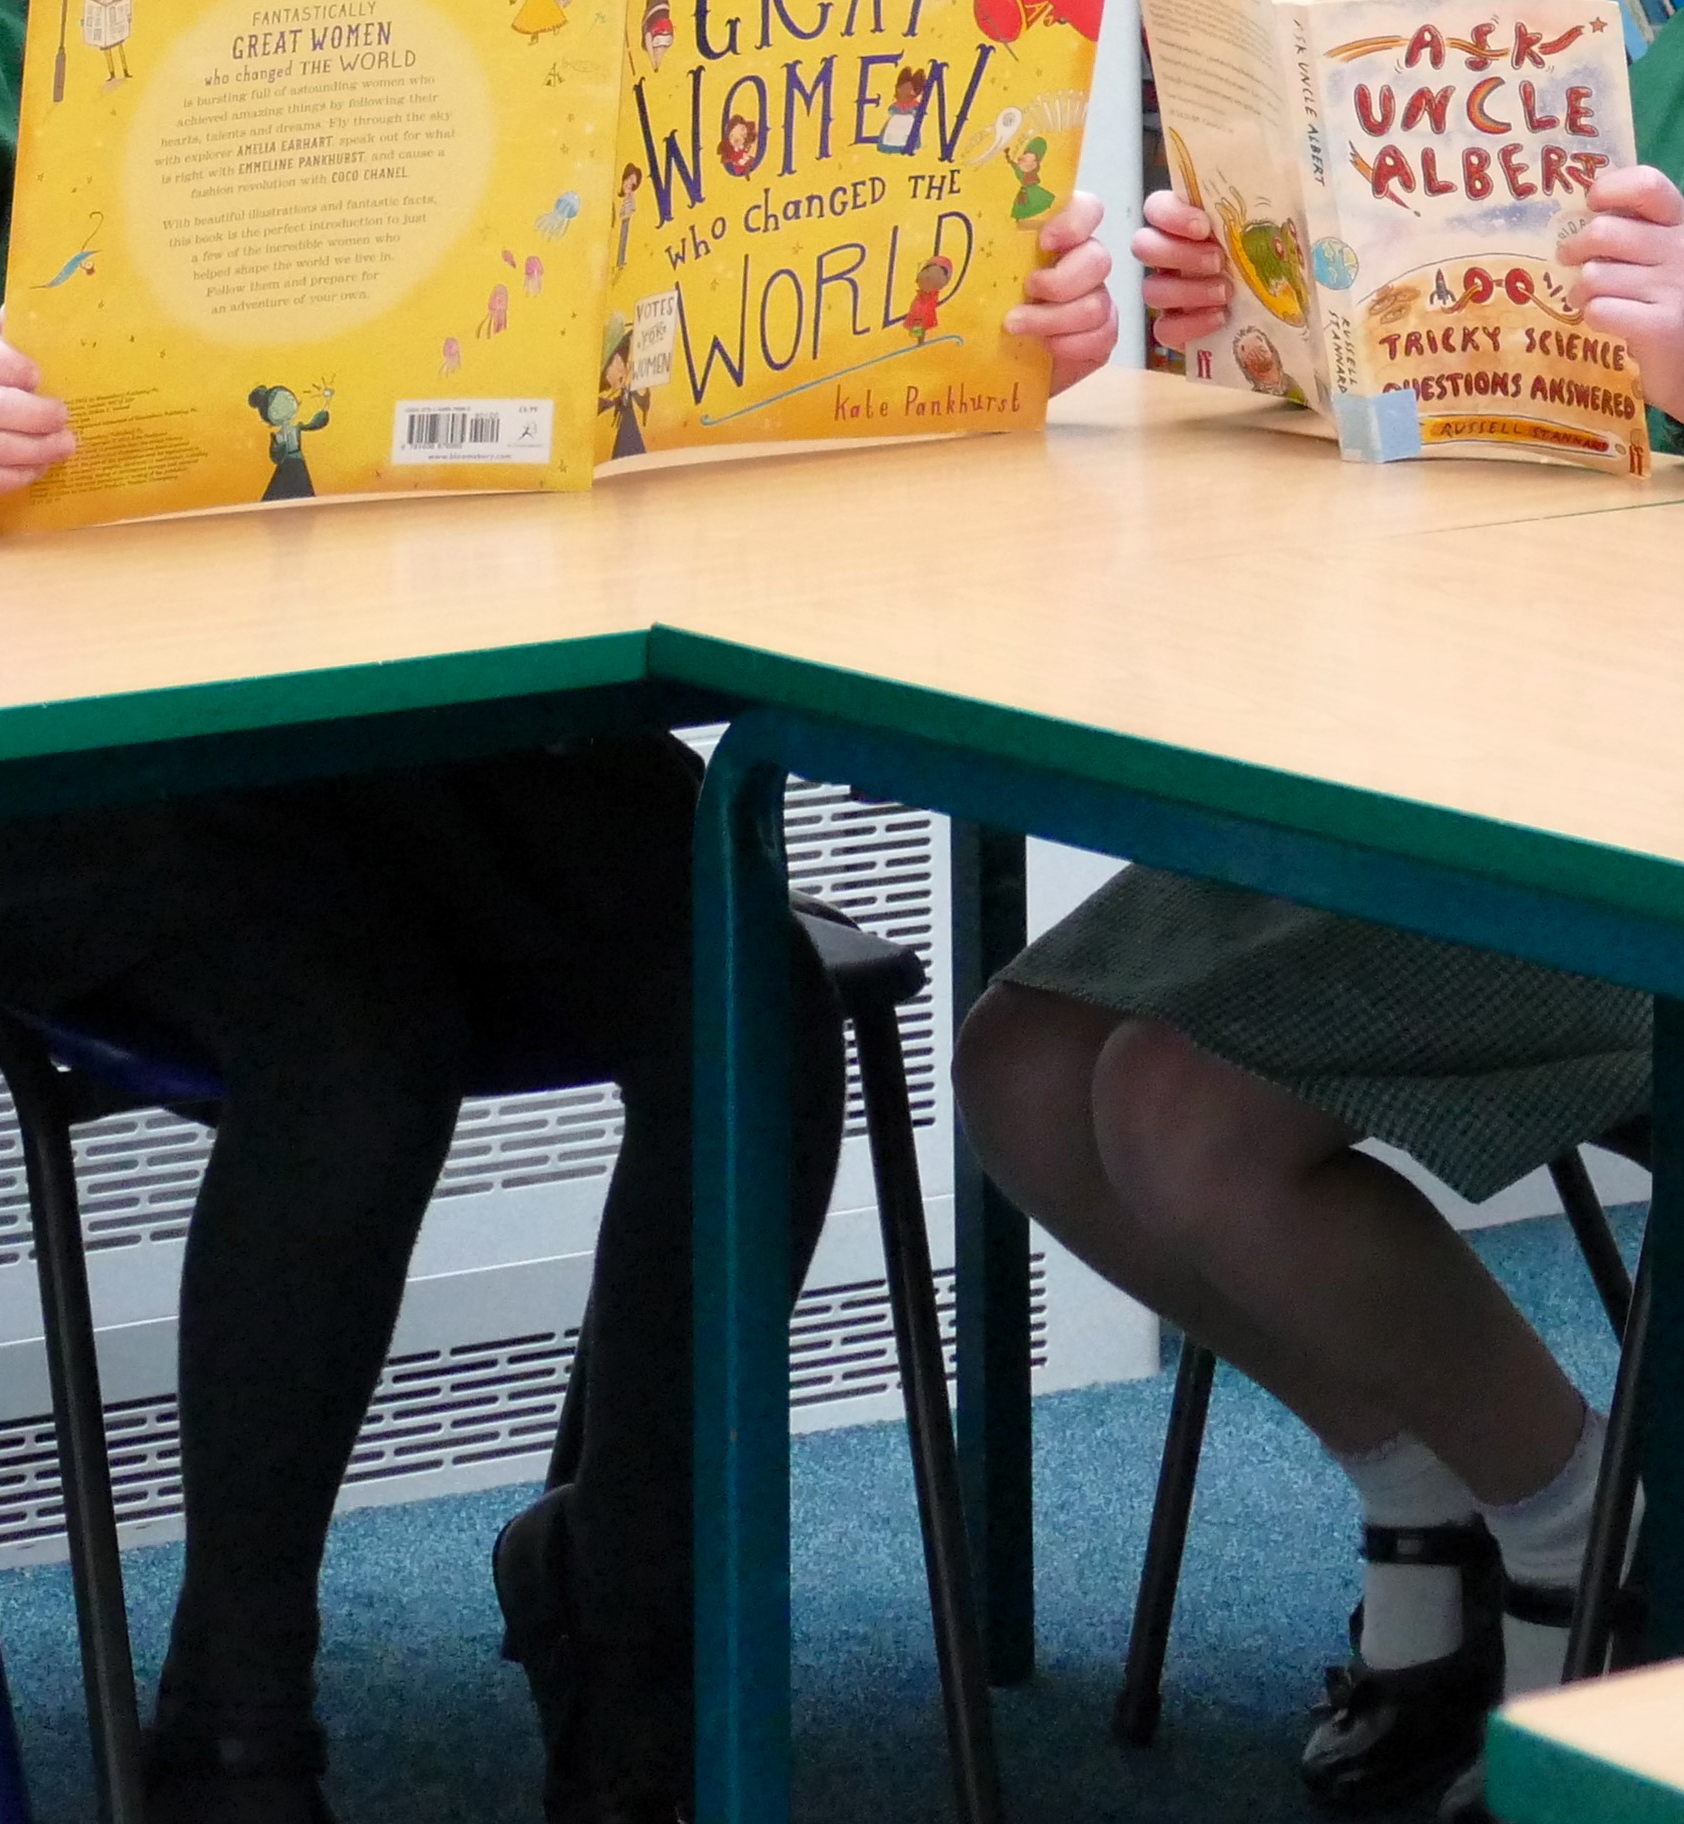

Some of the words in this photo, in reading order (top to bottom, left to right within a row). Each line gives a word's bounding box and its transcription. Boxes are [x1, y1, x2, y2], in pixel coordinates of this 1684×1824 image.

[253, 1, 376, 26] FANTASTICALLY
[233, 28, 302, 60] GREAT
[311, 21, 393, 51] WOMEN
[1293, 18, 1307, 57] ASK
[1404, 22, 1546, 72] ASK
[205, 67, 229, 87] who
[236, 60, 293, 83] changed
[299, 59, 332, 76] THE
[340, 50, 416, 72] WORLD
[1298, 59, 1318, 116] UNCLE
[184, 99, 193, 108] is
[197, 92, 246, 106] bursting
[251, 88, 271, 100] full
[274, 86, 287, 96] of
[290, 80, 357, 96] astounding
[362, 78, 405, 89] women
[409, 75, 435, 85] who
[1353, 75, 1600, 137] UNCLE
[236, 141, 276, 157] AMELIA
[633, 43, 995, 229] WOMEN
[1307, 120, 1326, 187] ALBERT
[238, 158, 294, 175] EMMELINE
[332, 170, 359, 183] COCO
[909, 168, 962, 200] THE
[1371, 142, 1611, 201] ALBERT
[636, 297, 674, 320] VOTES
[675, 210, 974, 406] WORLD
[631, 352, 671, 380] WOMEN
[1340, 314, 1358, 386] RUSSELL
[1379, 325, 1503, 361] TRICKY
[1524, 329, 1626, 372] SCIENCE
[904, 382, 1021, 417] Pankhurst
[1530, 375, 1636, 421] ANSWERED
[1440, 419, 1522, 438] RUSSELL
